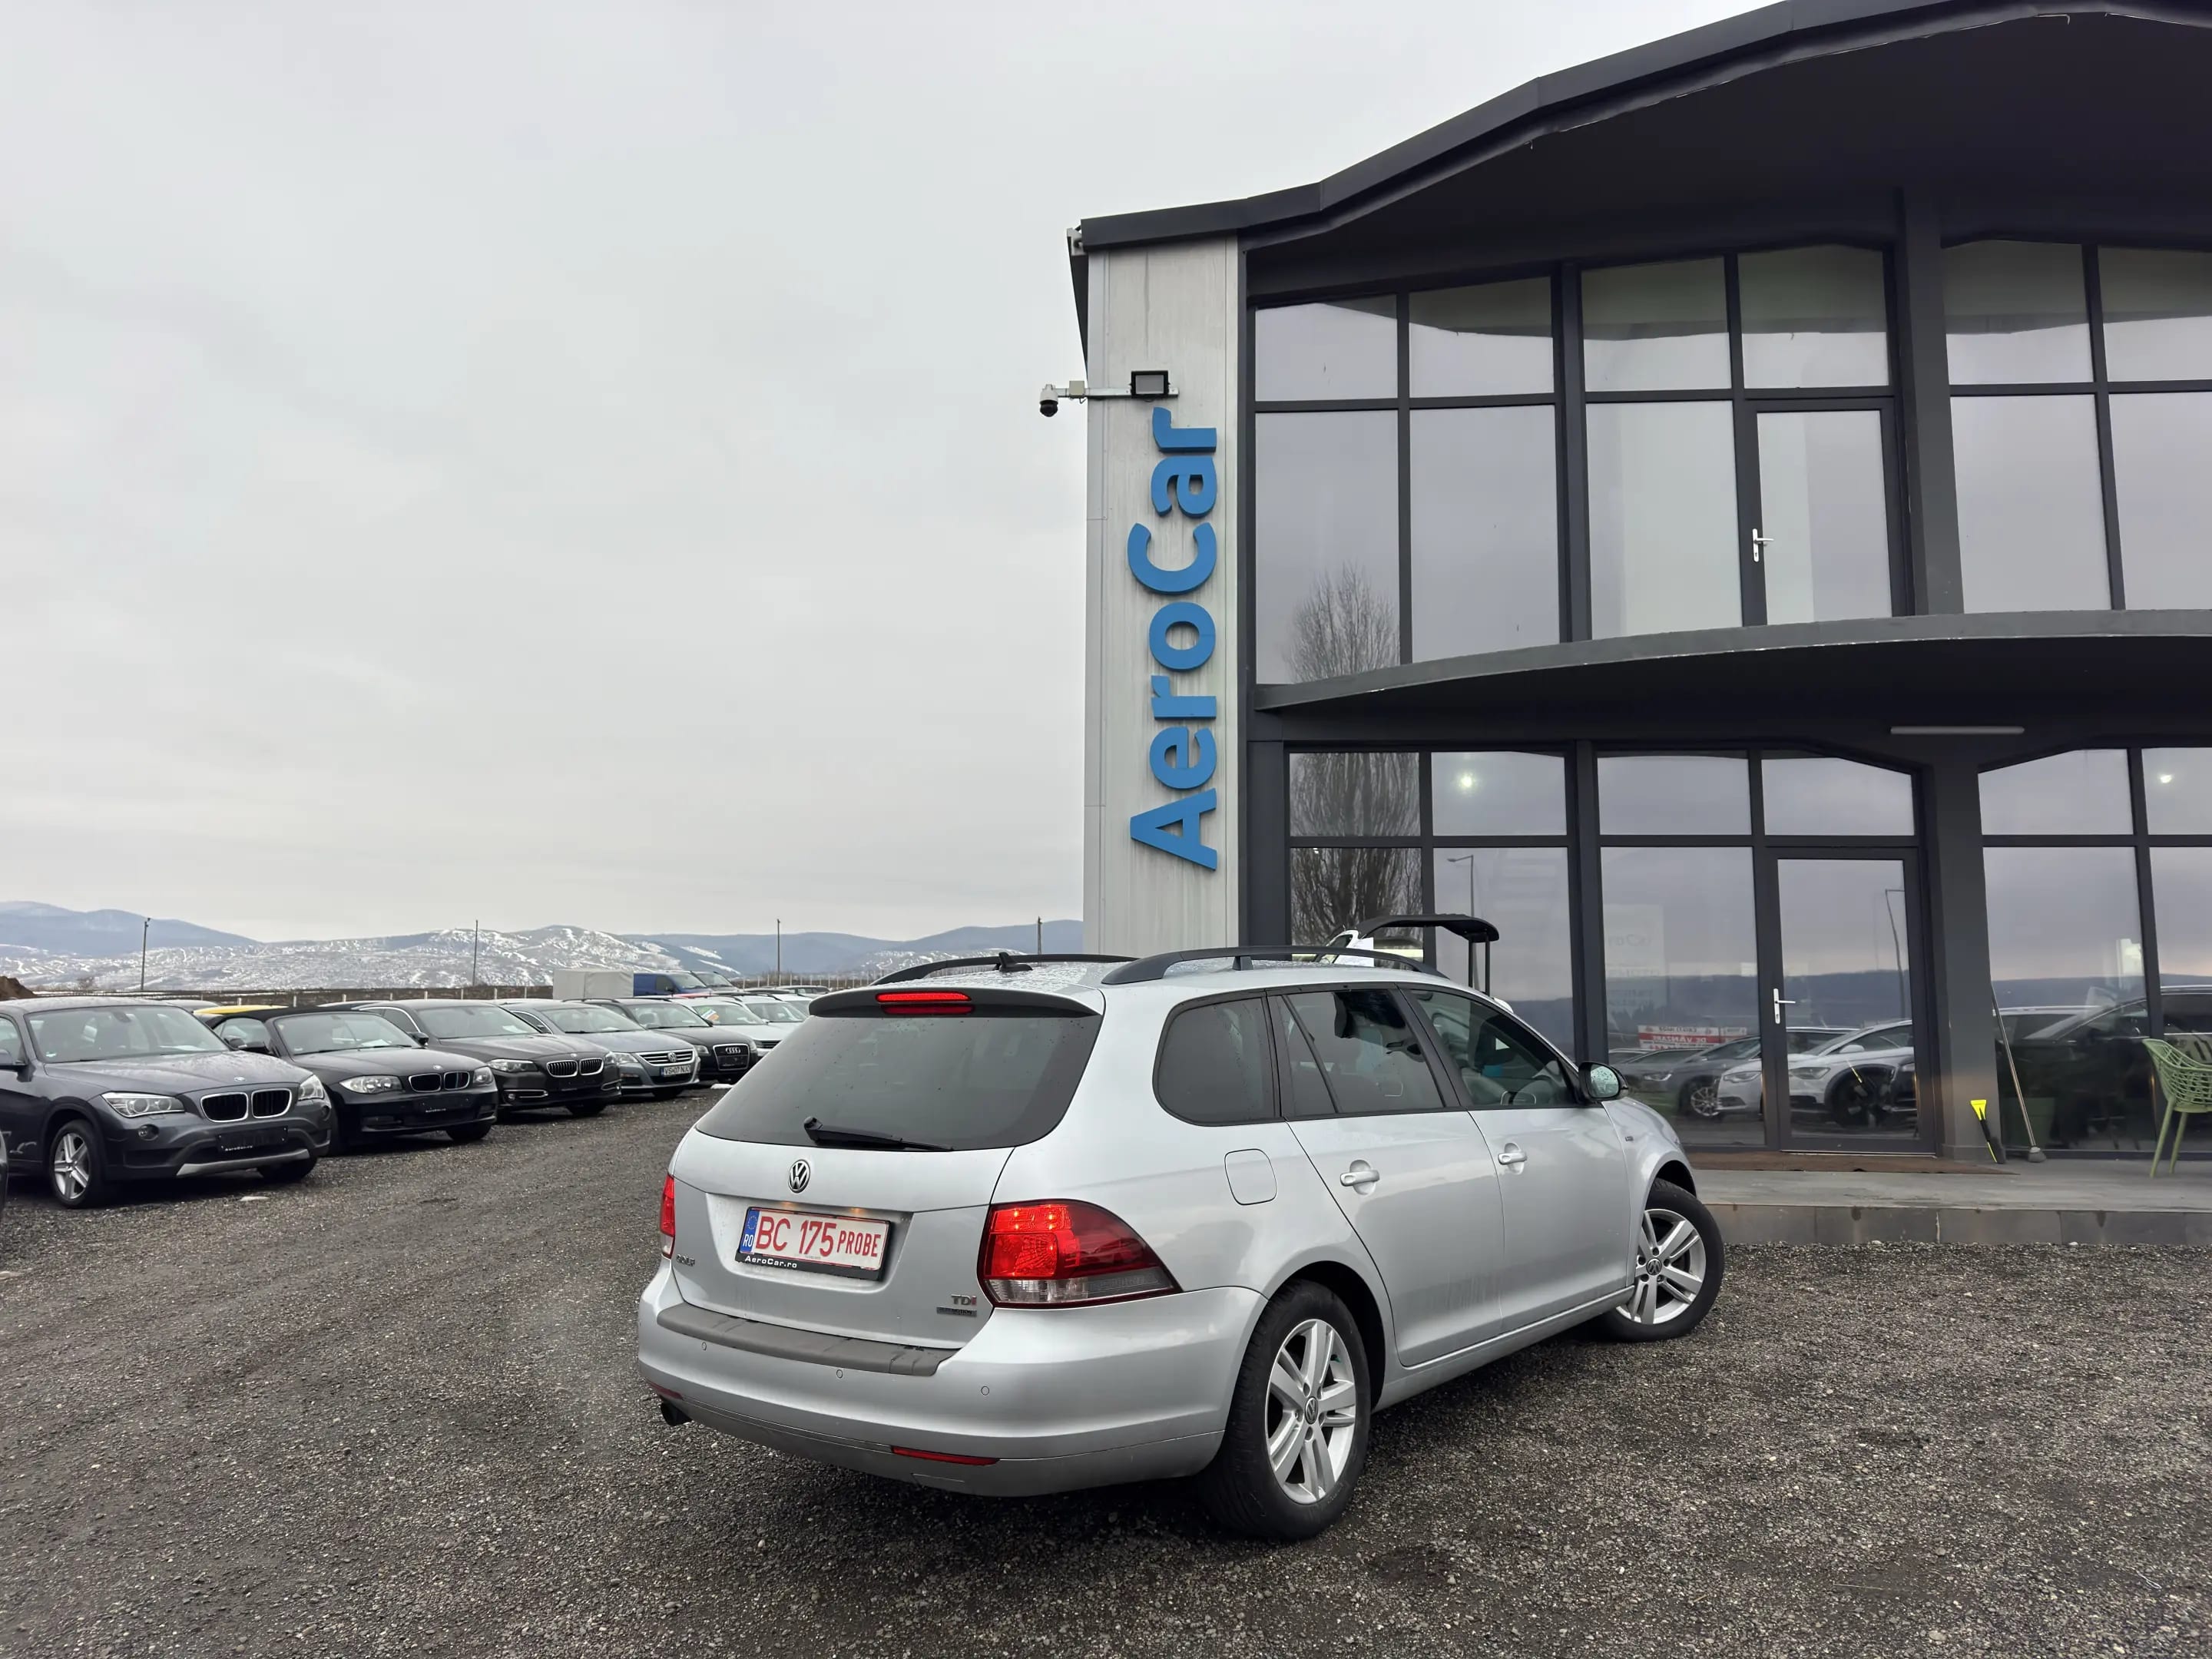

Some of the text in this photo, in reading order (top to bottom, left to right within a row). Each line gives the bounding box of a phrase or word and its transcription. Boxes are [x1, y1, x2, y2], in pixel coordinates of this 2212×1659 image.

[1127, 406, 1217, 871] AeroCar
[743, 1233, 754, 1247] RO
[755, 1216, 882, 1257] BC 175 PROBE
[744, 1254, 798, 1269] AeroCar.ro
